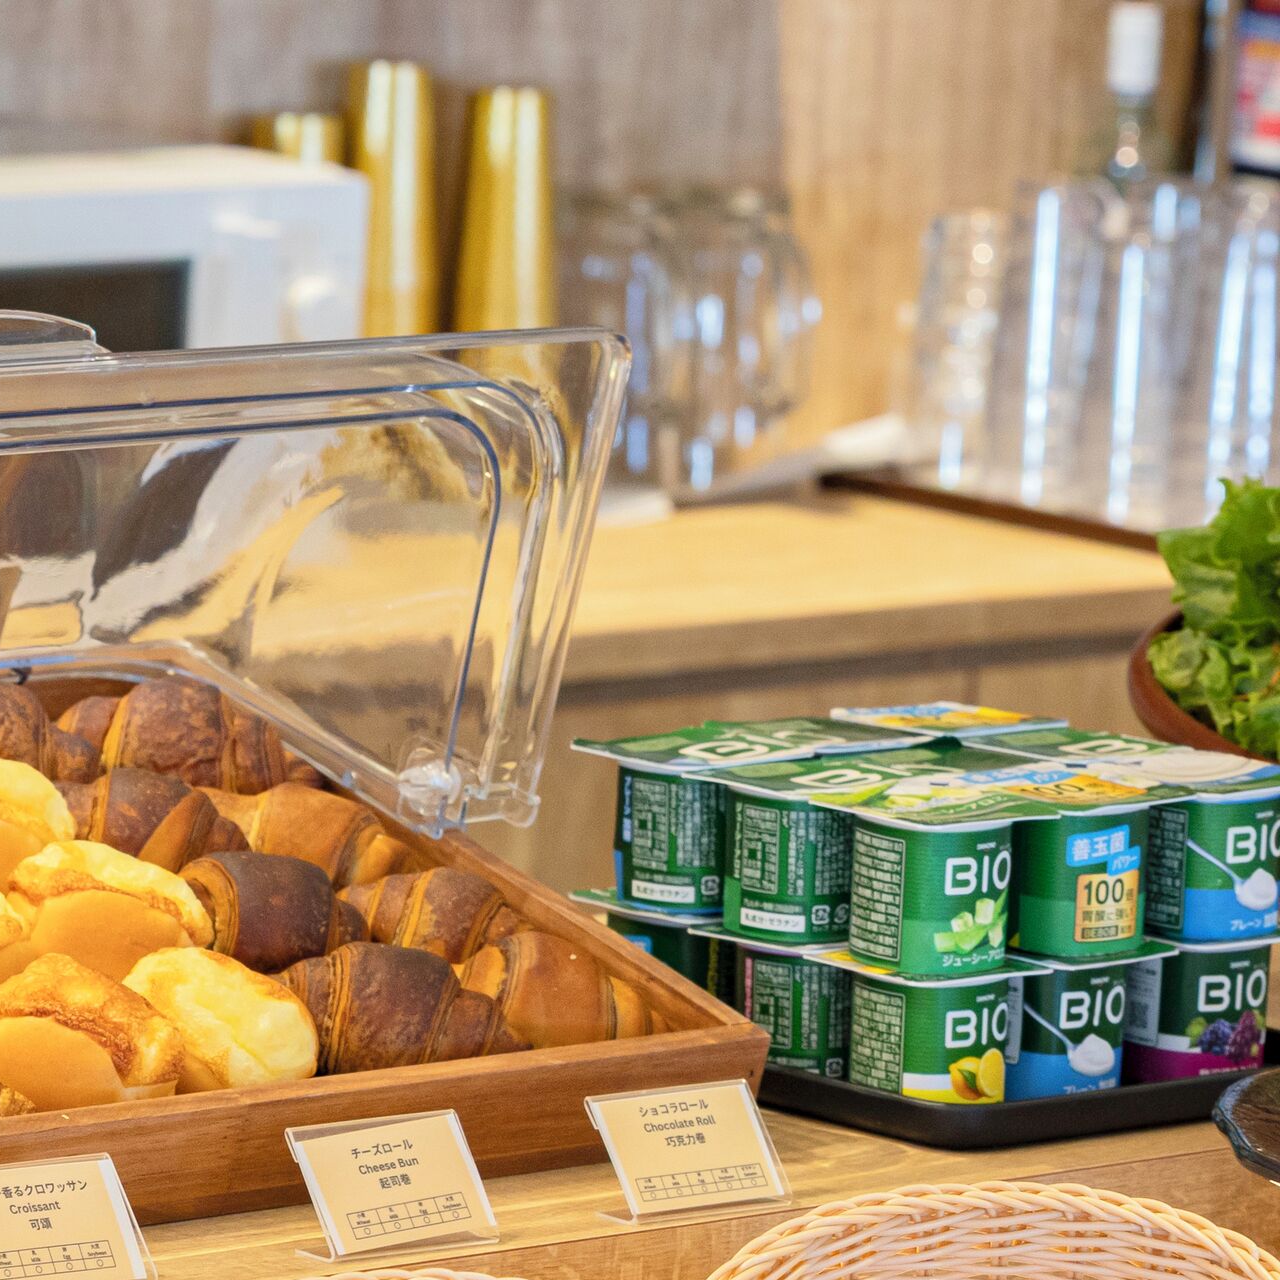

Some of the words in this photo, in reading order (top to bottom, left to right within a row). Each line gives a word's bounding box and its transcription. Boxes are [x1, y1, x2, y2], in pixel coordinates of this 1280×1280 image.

[944, 850, 1012, 896] BIO
[1198, 968, 1268, 1013] BIO
[1059, 984, 1126, 1030] BIO
[945, 1002, 1008, 1049] BIO
[639, 1098, 709, 1118] ショコラロール
[643, 1119, 695, 1133] Chocolate
[696, 1115, 716, 1128] Roll
[351, 1138, 414, 1160] チーズロール
[358, 1160, 397, 1176] Cheese
[399, 1156, 420, 1169] Bun
[9, 1200, 61, 1215] Croissant
